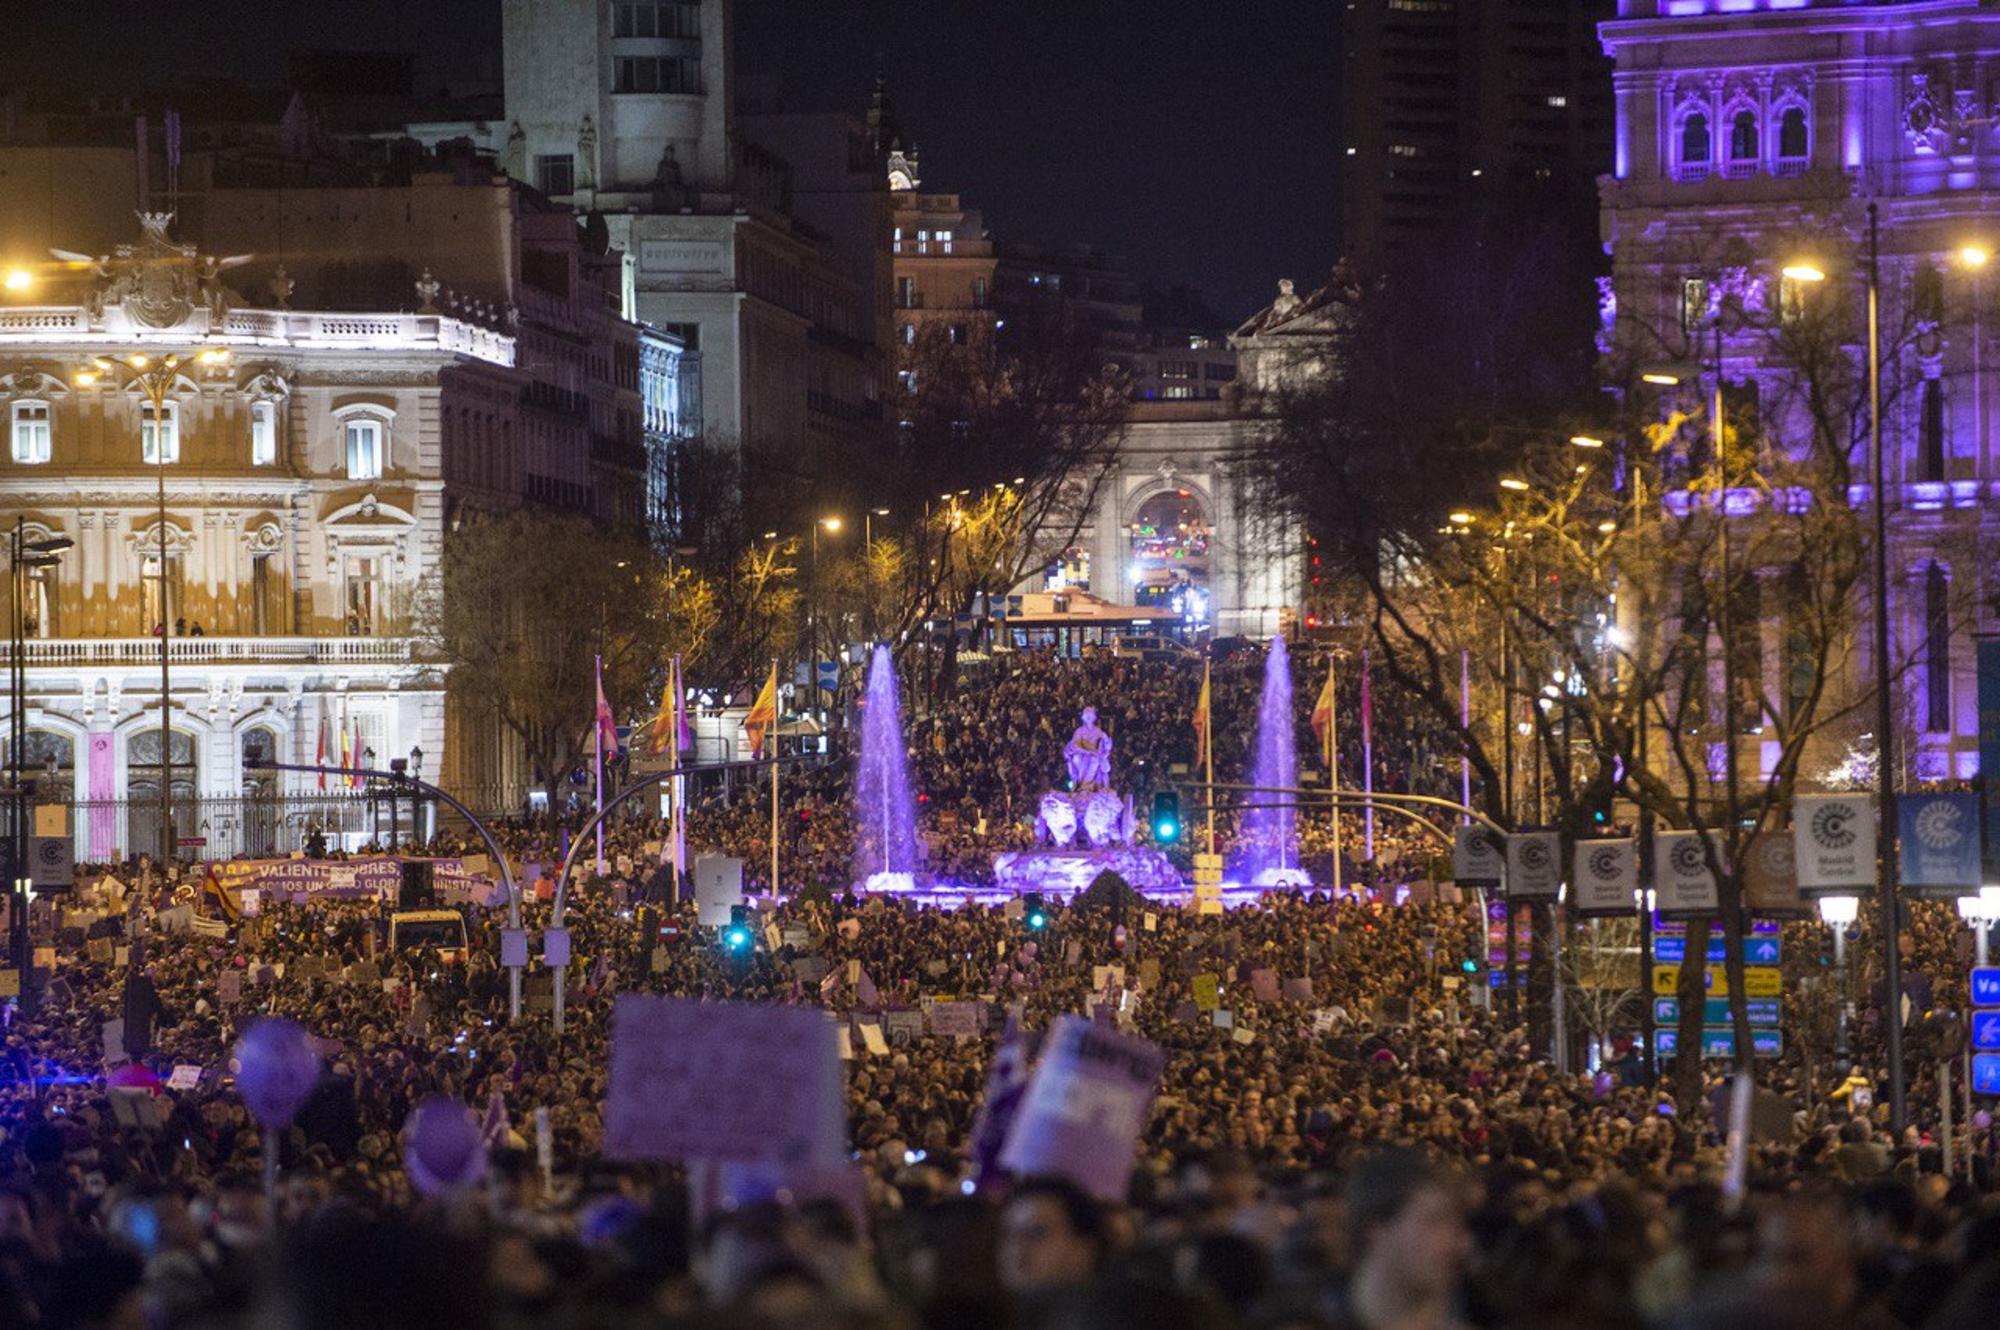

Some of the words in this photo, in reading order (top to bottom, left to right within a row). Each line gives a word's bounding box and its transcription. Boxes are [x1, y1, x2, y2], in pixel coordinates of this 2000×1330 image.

[1818, 856, 1855, 866] Madrid
[258, 863, 332, 878] VALIENTE
[1817, 866, 1857, 877] Central
[305, 880, 325, 892] UN
